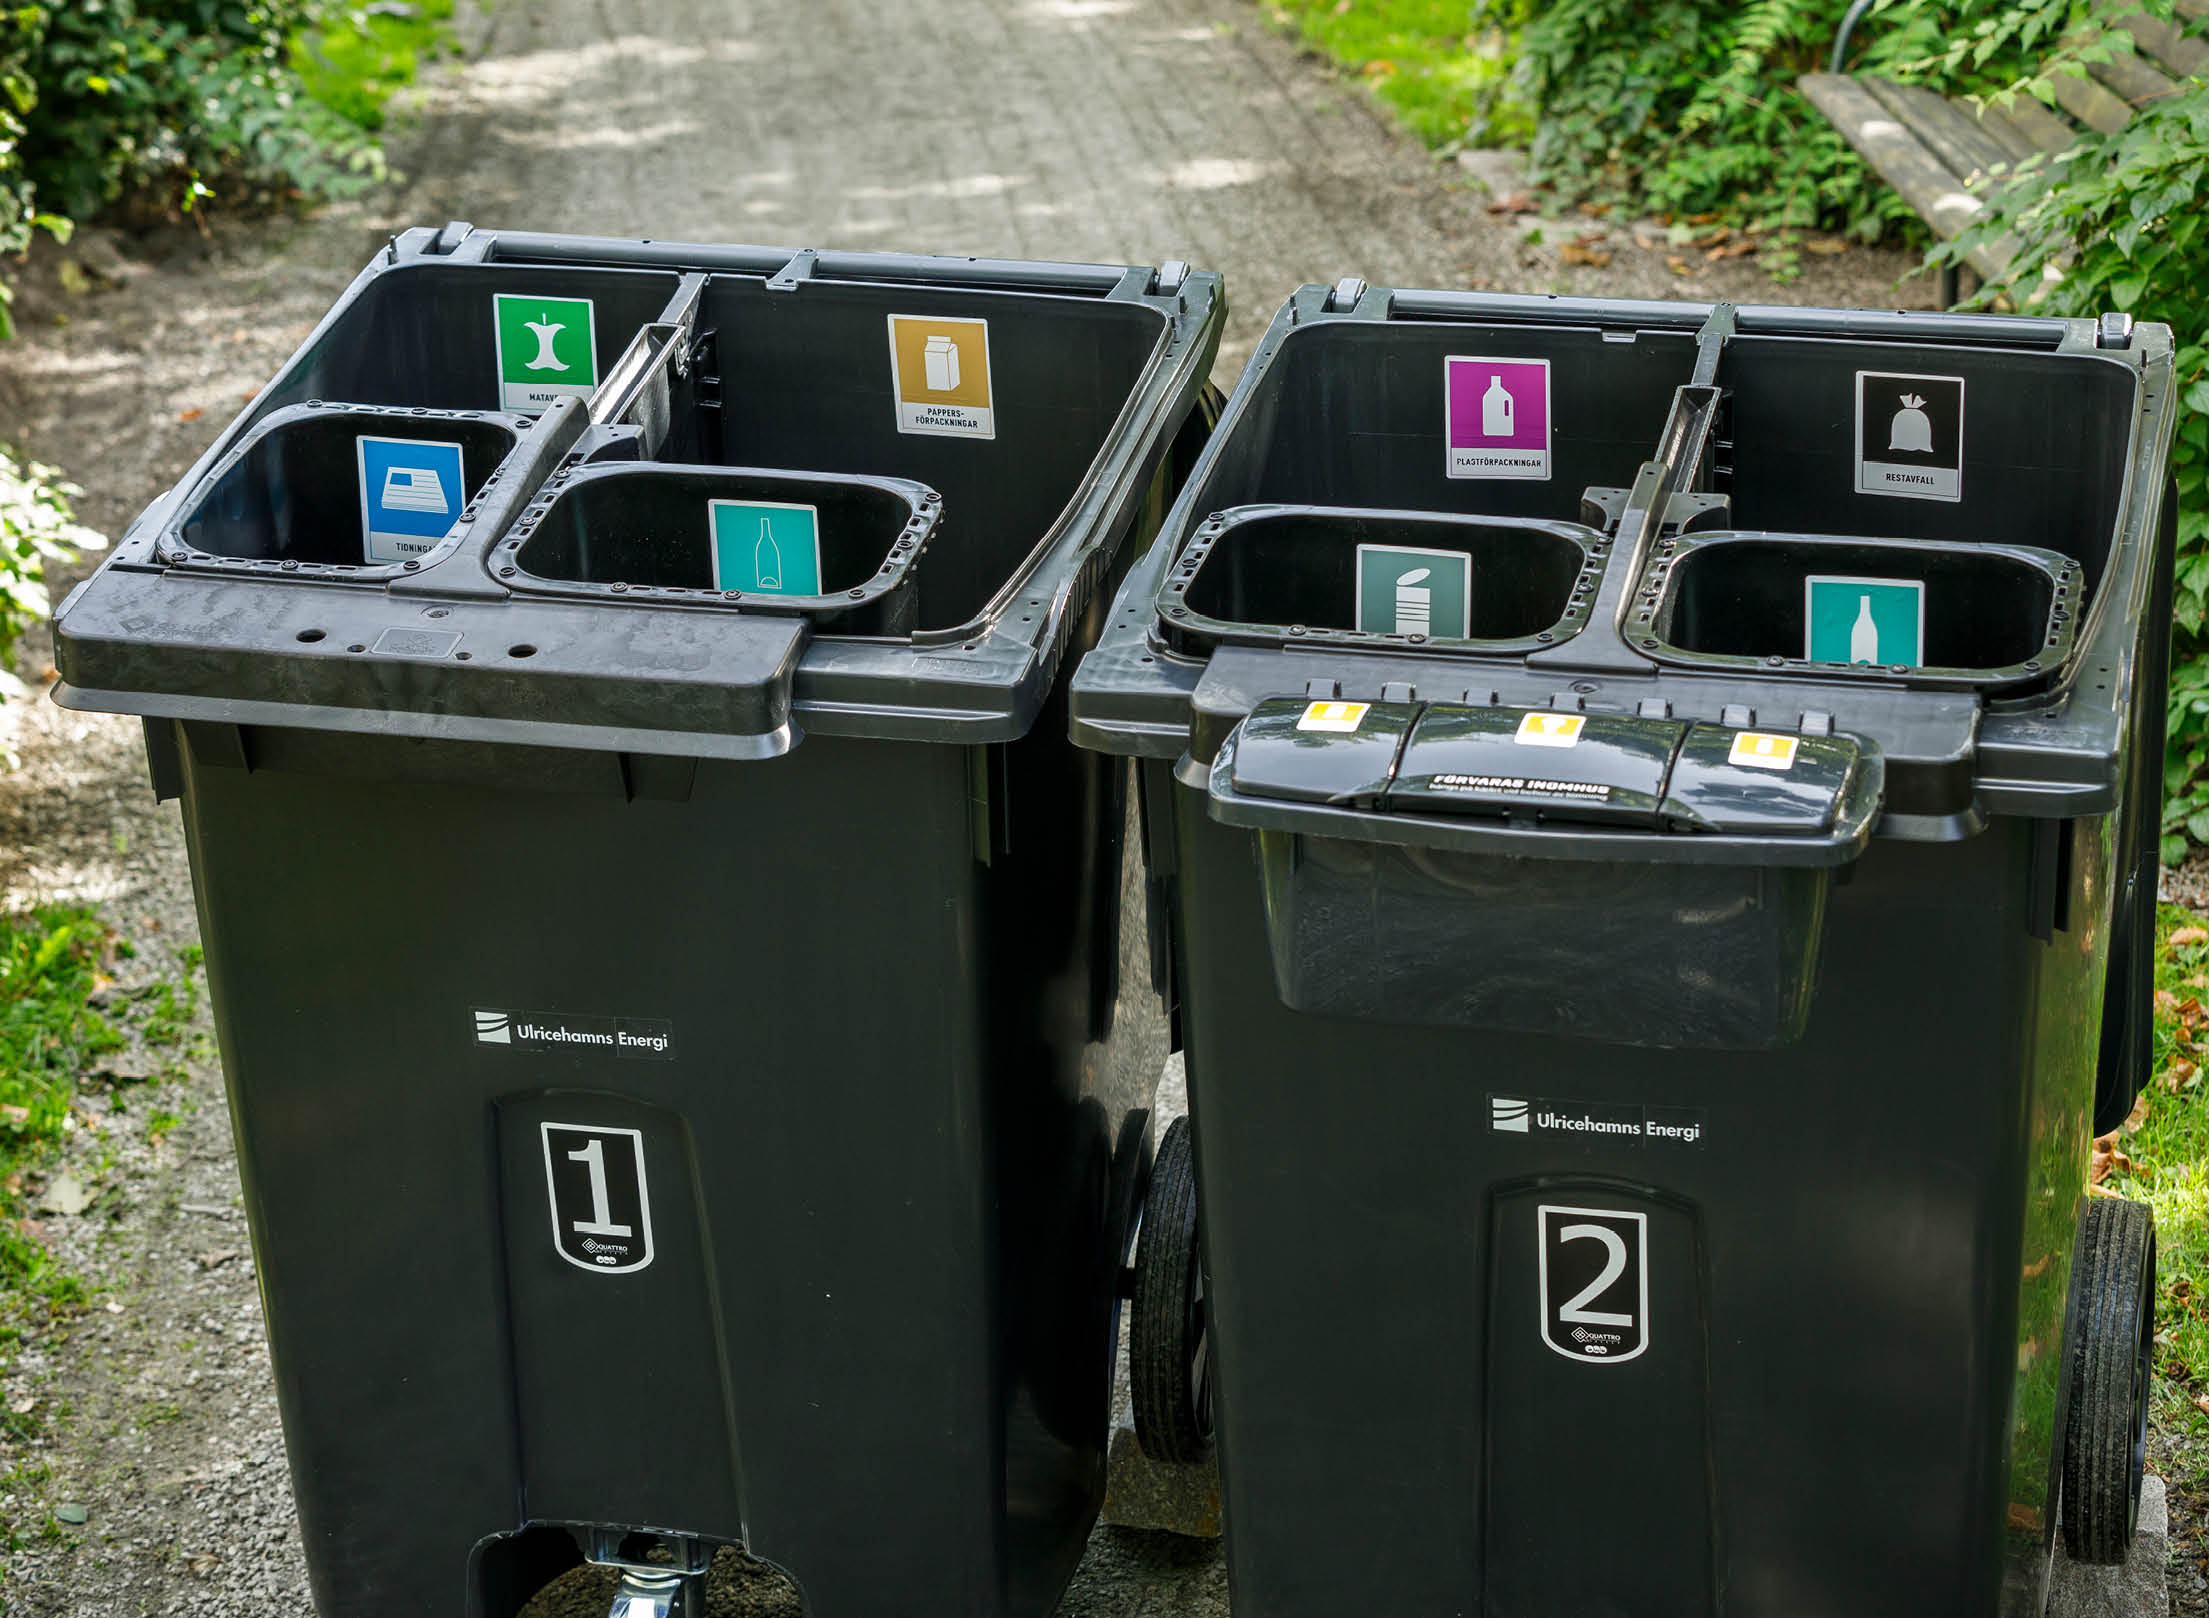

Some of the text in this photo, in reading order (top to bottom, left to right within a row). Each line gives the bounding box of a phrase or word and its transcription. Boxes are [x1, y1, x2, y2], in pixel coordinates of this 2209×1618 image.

[927, 407, 965, 417] PAPPERS-
[915, 415, 978, 428] FÖRPACKNINGAR
[1456, 457, 1542, 467] PLASTFÖRPACKNINGAR
[1886, 473, 1935, 485] RESTAVFALL
[1433, 774, 1525, 788] FÖRVARAS
[516, 1023, 669, 1051] Ulricehamns Energi
[1537, 1112, 1700, 1142] Ulricehamns Energi
[567, 1139, 633, 1238] 1
[1559, 1224, 1633, 1327] 2
